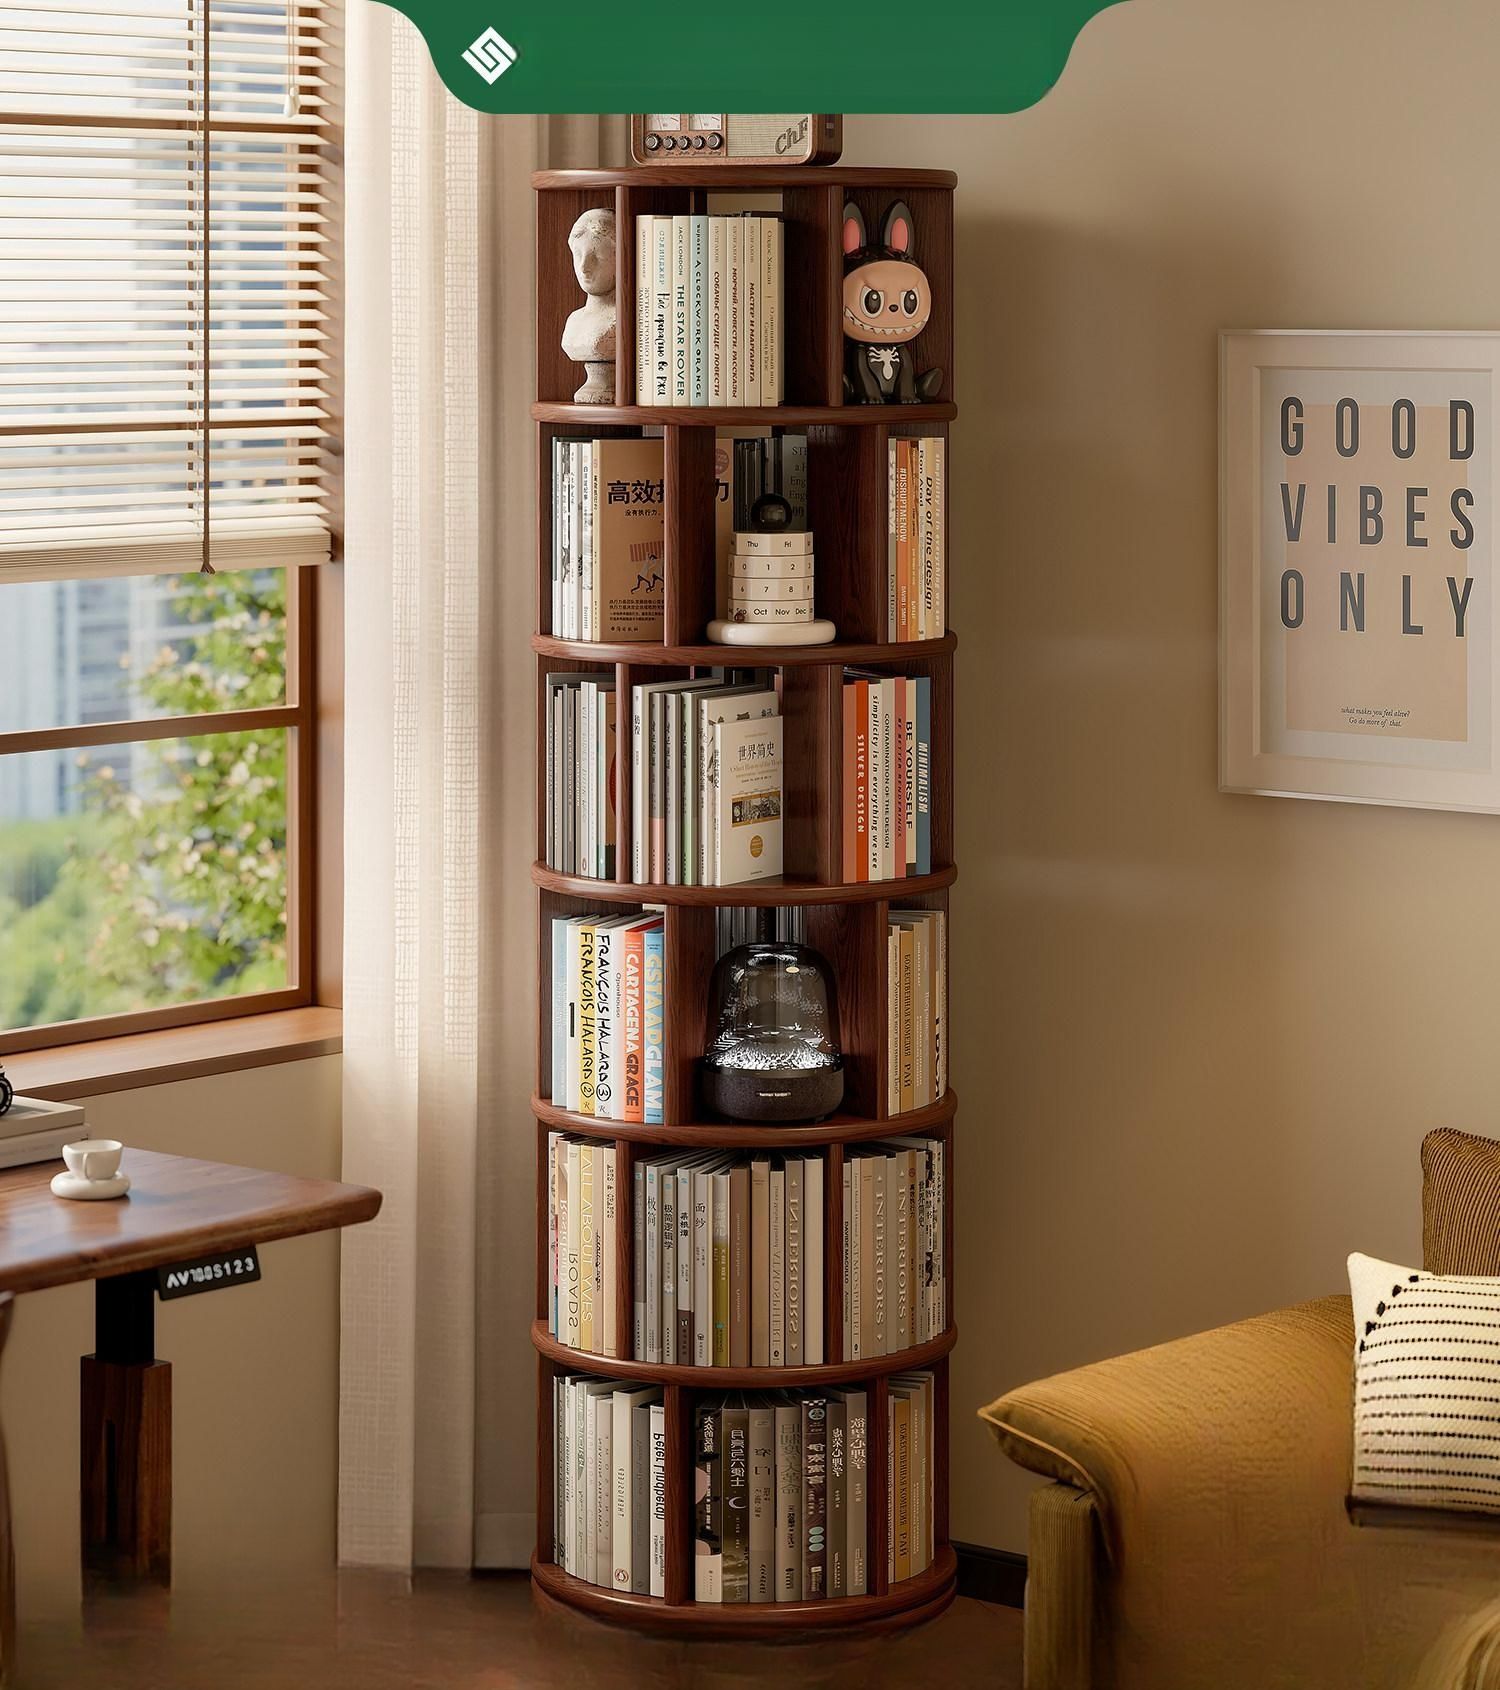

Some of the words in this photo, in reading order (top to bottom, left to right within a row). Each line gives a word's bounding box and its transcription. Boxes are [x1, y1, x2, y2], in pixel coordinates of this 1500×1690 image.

[750, 320, 755, 328] И
[1279, 396, 1475, 460] GOOD
[926, 511, 933, 527] of
[1279, 482, 1475, 550] VIBES
[925, 560, 933, 609] design
[1280, 569, 1474, 638] ONLY
[753, 608, 768, 616] Oct
[871, 695, 880, 747] simplicity
[906, 721, 913, 741] BE
[1341, 706, 1355, 714] what
[1382, 708, 1393, 718] feel
[1349, 716, 1358, 724] Go
[1380, 719, 1387, 728] of
[738, 741, 775, 761] 世界简史
[857, 734, 865, 779] SILVER
[872, 750, 880, 759] is
[872, 763, 880, 773] in
[884, 786, 890, 798] OF
[918, 742, 928, 813] MINIMALISM
[857, 786, 865, 833] DESIGN
[870, 776, 880, 831] everything
[872, 835, 880, 848] we
[872, 852, 880, 869] see
[904, 954, 912, 1017] БОЖЕСТВЕННАЯ
[581, 1016, 595, 1080] HALARD
[597, 1017, 611, 1082] HALARD
[904, 1018, 912, 1057] КОМЕДИЯ
[904, 1063, 913, 1088] РАЙ
[582, 1156, 592, 1187] ALL
[582, 1197, 592, 1265] ABOUT
[875, 1192, 884, 1326] INTERIORS
[898, 1186, 906, 1320] INTERIORS
[582, 1274, 592, 1322] YVES
[900, 1533, 908, 1557] РАЙ
